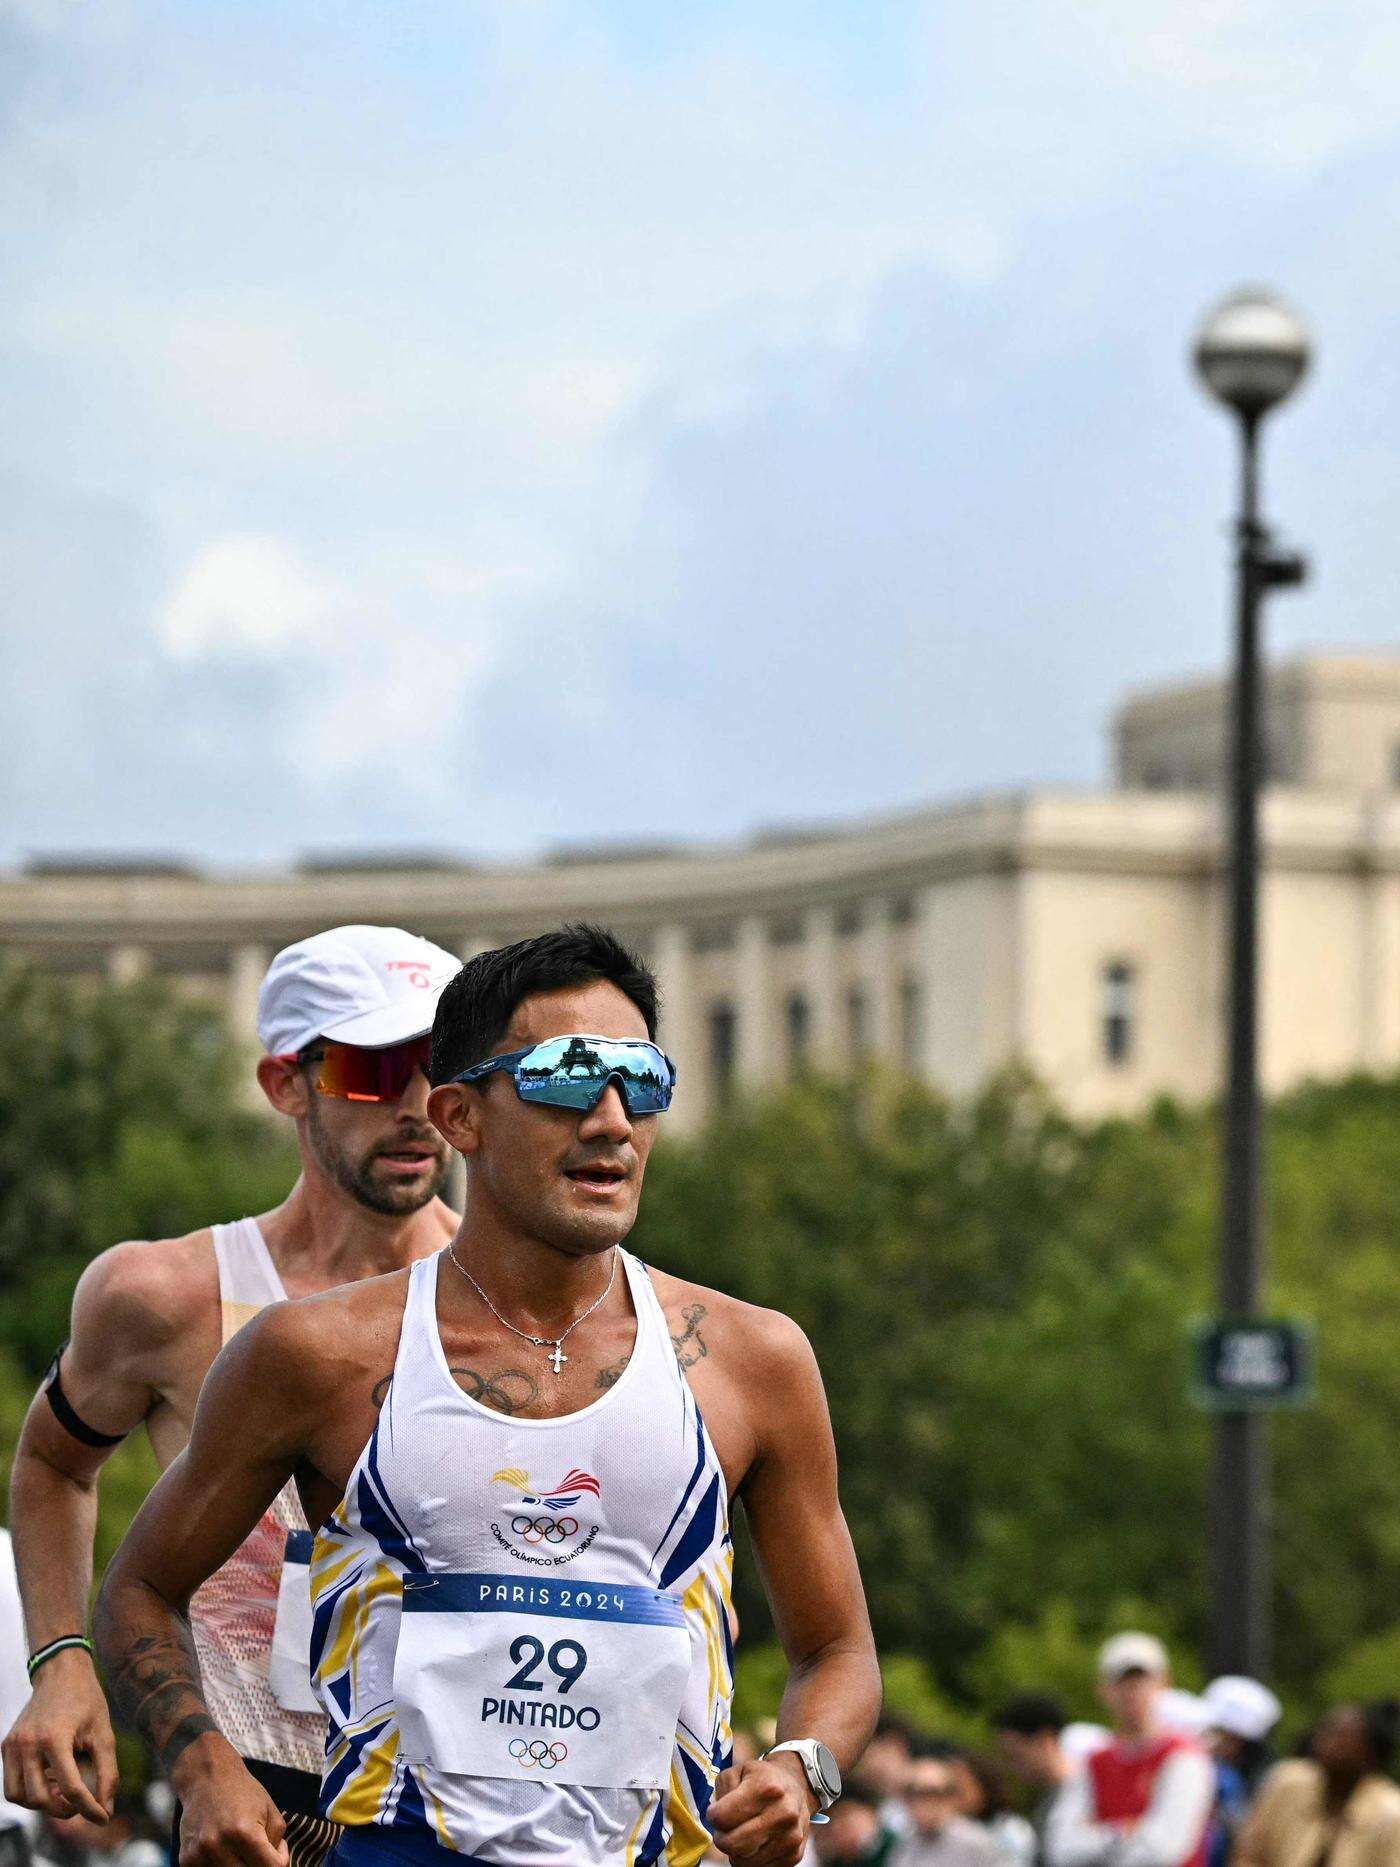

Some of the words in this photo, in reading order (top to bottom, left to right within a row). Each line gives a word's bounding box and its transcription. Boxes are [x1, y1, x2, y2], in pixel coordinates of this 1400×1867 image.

[554, 1525, 600, 1566] ECUATORIANO
[560, 1590, 624, 1612] 2024
[503, 1634, 588, 1694] 29
[481, 1697, 601, 1732] PINTADO
